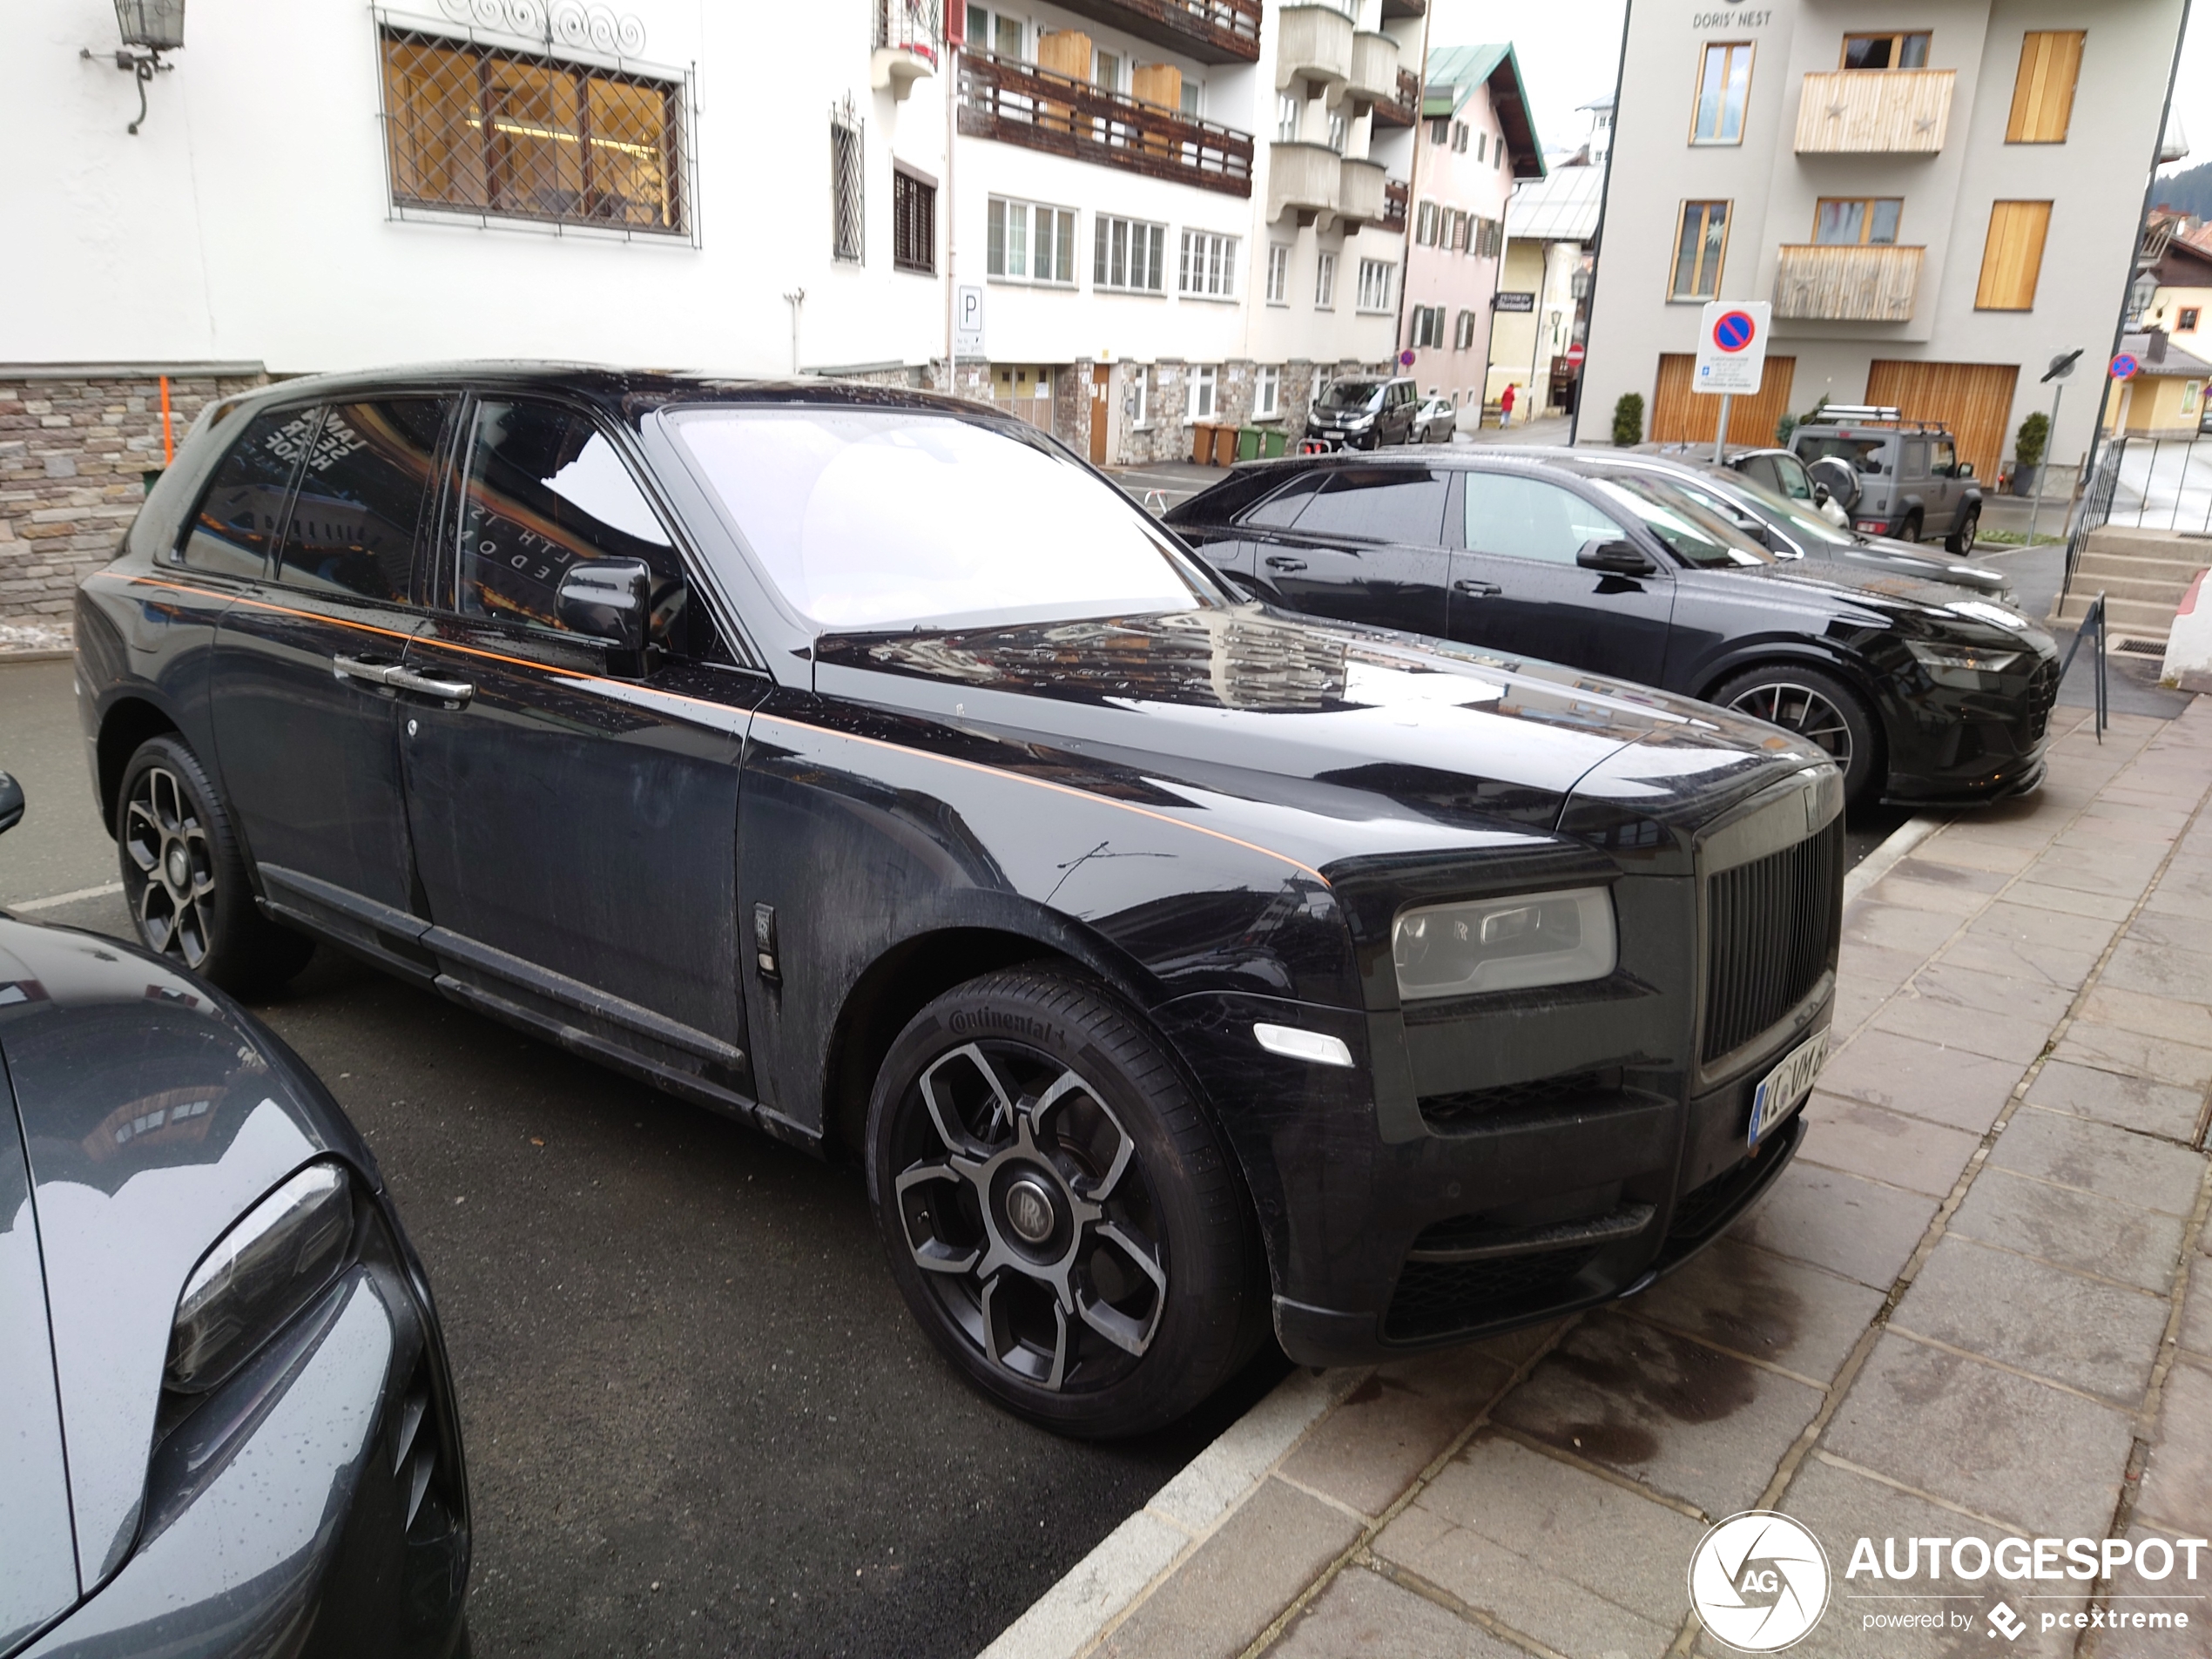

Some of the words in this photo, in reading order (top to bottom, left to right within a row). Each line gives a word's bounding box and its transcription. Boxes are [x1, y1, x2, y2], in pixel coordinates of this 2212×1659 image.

[1693, 10, 1736, 29] DORIS'
[1738, 10, 1772, 27] NEST
[966, 295, 976, 323] P
[948, 1006, 1052, 1042] Continental
